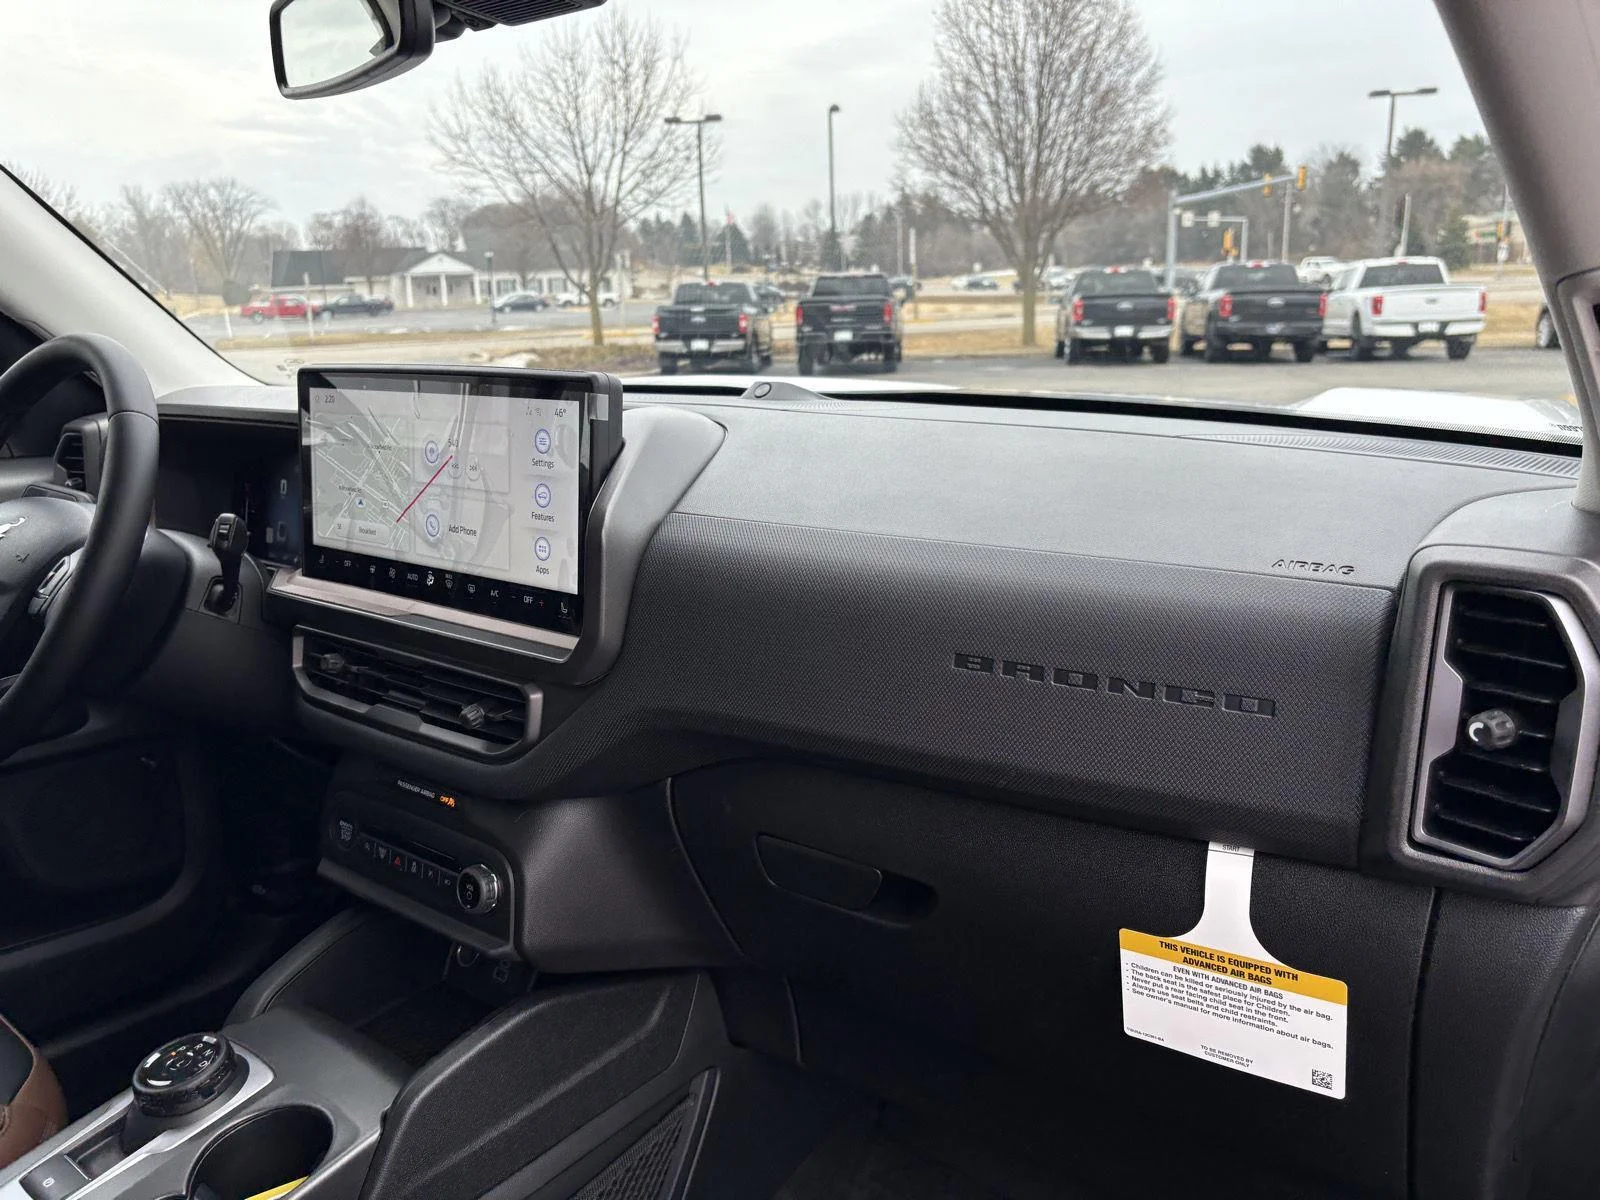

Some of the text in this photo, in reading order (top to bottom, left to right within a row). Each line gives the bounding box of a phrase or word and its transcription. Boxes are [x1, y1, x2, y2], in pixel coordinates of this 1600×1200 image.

[532, 458, 554, 469] Settings
[531, 511, 555, 523] Features
[448, 524, 477, 537] Add Phone
[407, 573, 419, 581] AUTO
[536, 565, 550, 575] Apps
[1271, 558, 1355, 575] AIRBAG
[523, 596, 534, 604] OFF
[953, 652, 1276, 717] BRONCO
[1159, 941, 1298, 981] THIS VEHICLE IS EQUIPPED WITH
[1183, 956, 1272, 985] ADVANCED AIR BAGS
[1131, 962, 1159, 974] Children
[1160, 970, 1173, 978] can
[1185, 976, 1204, 987] killed
[1215, 985, 1247, 999] seriously
[1250, 994, 1276, 1006] injured
[1278, 1001, 1287, 1010] by
[1290, 1004, 1301, 1013] the
[1304, 1008, 1314, 1016] air
[1316, 1011, 1333, 1021] bag.
[1131, 969, 1144, 977] The
[1145, 972, 1161, 981] back
[1163, 978, 1177, 986] seat
[1186, 984, 1198, 992] the
[1200, 987, 1221, 998] safest
[1223, 994, 1244, 1003] place
[1256, 1003, 1290, 1017] Children.
[1173, 966, 1283, 1000] EVEN WITH ADVANCED AIR BAGS
[1132, 975, 1150, 986] Never
[1171, 987, 1184, 995] rear
[1186, 990, 1208, 1001] facing
[1209, 997, 1227, 1007] child
[1229, 1003, 1244, 1011] seat
[1255, 1009, 1267, 1017] the
[1268, 1013, 1289, 1024] front.
[1132, 982, 1156, 993] Always
[1171, 993, 1185, 1002] seat
[1187, 997, 1204, 1007] belts
[1205, 1002, 1219, 1011] and
[1221, 1006, 1239, 1016] child
[1240, 1013, 1278, 1027] restraints.
[1132, 987, 1334, 1049] See owner's manual for more information about air bags.
[1204, 1050, 1250, 1068] CUSTOMER ONLY
[1218, 1049, 1245, 1062] REMOVED
[1245, 1056, 1253, 1064] BY
